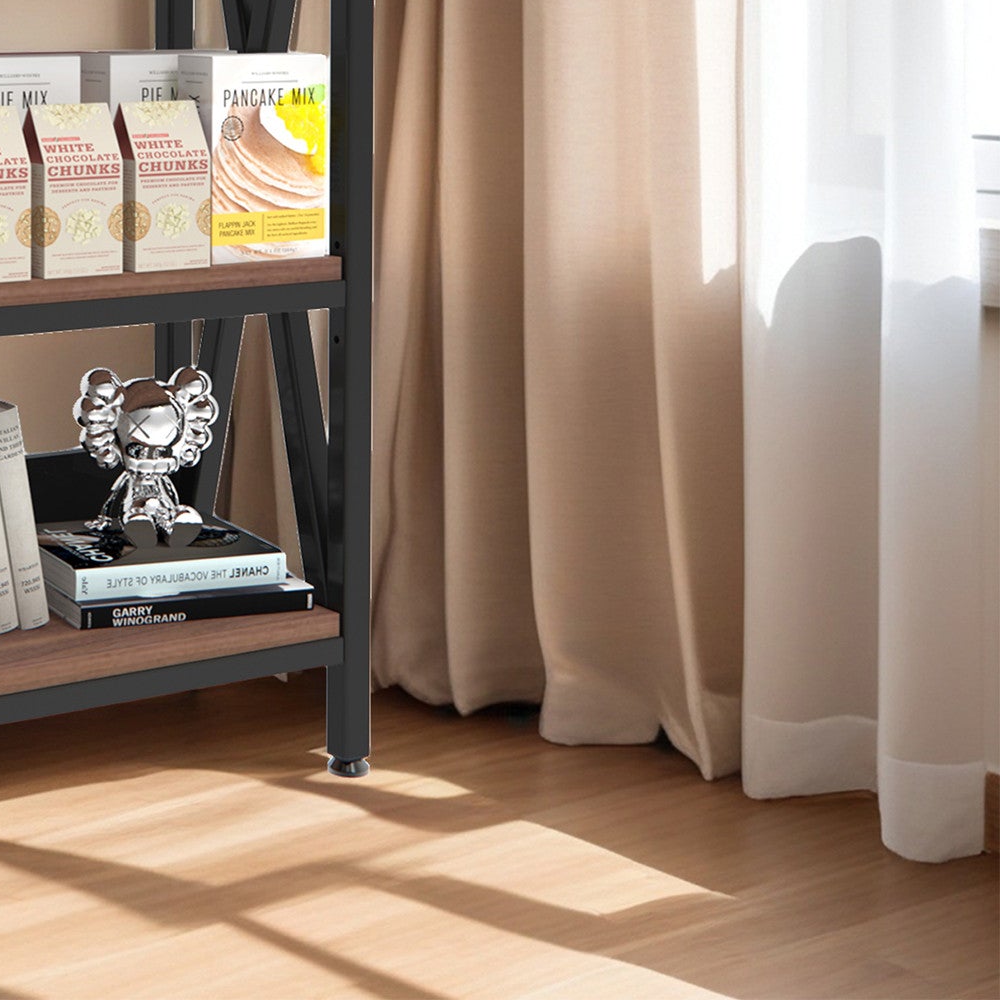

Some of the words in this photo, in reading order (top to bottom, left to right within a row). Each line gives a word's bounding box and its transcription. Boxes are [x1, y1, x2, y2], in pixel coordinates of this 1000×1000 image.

[22, 89, 48, 109] MIX
[223, 88, 285, 108] PANCAKE
[291, 87, 316, 106] MIX
[43, 143, 95, 153] WHITE
[133, 139, 183, 150] WHITE
[46, 153, 120, 164] CHOCOLATE
[137, 149, 207, 159] CHOCOLATE
[47, 163, 120, 177] CHUNKS
[138, 159, 208, 172] CHUNKS
[218, 220, 241, 230] FLAPPIN
[242, 219, 256, 228] JACK
[218, 229, 244, 237] PANCAKE
[245, 228, 255, 236] MIX
[112, 605, 154, 618] GARRY
[112, 612, 187, 628] WINOGRAND
